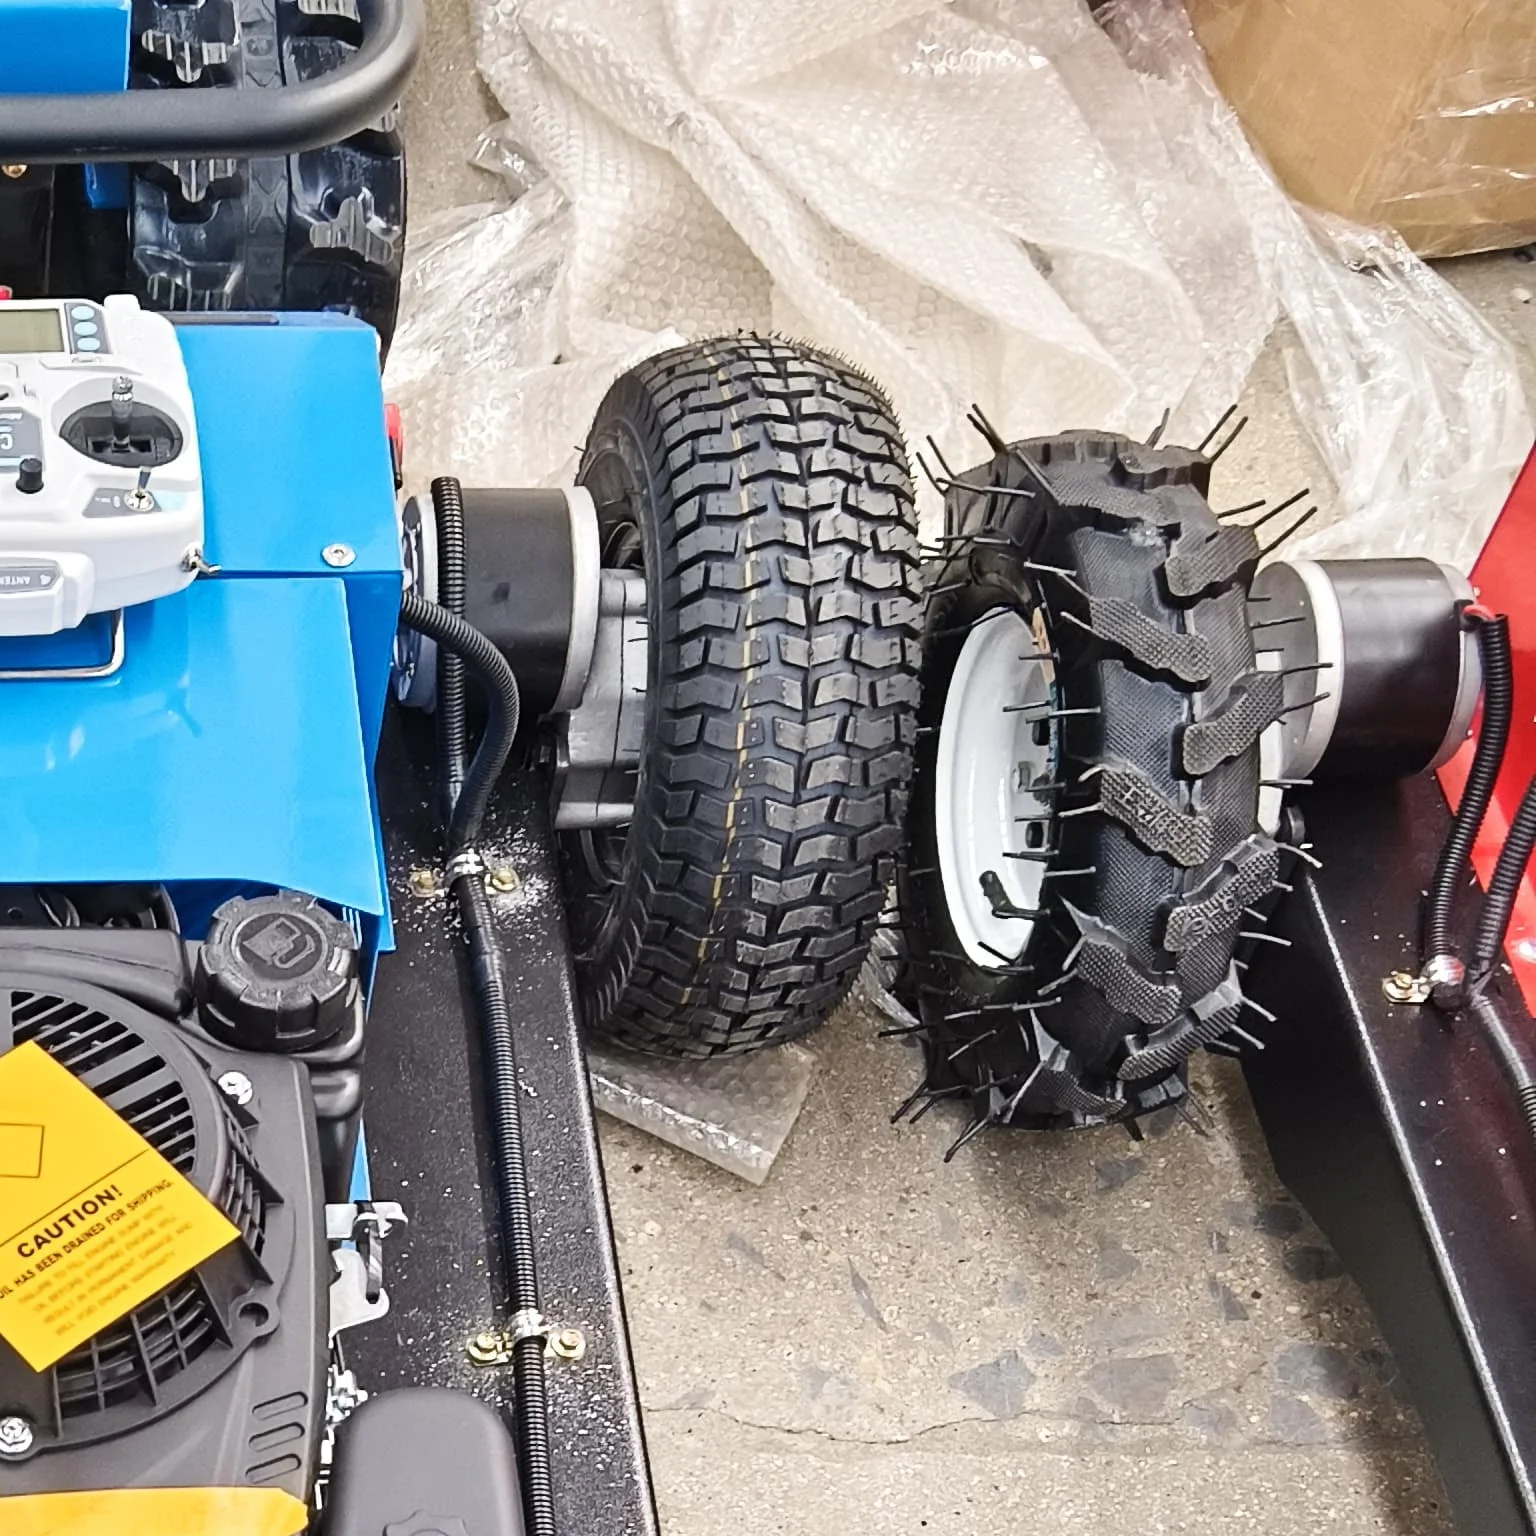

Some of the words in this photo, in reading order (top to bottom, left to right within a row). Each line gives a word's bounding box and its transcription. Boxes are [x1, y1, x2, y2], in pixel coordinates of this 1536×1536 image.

[13, 1269, 36, 1287] HAS
[35, 1252, 63, 1273] BEEN
[61, 1222, 106, 1255] DRAINED
[104, 1208, 127, 1226] FOR
[17, 1184, 123, 1258] CAUTION!
